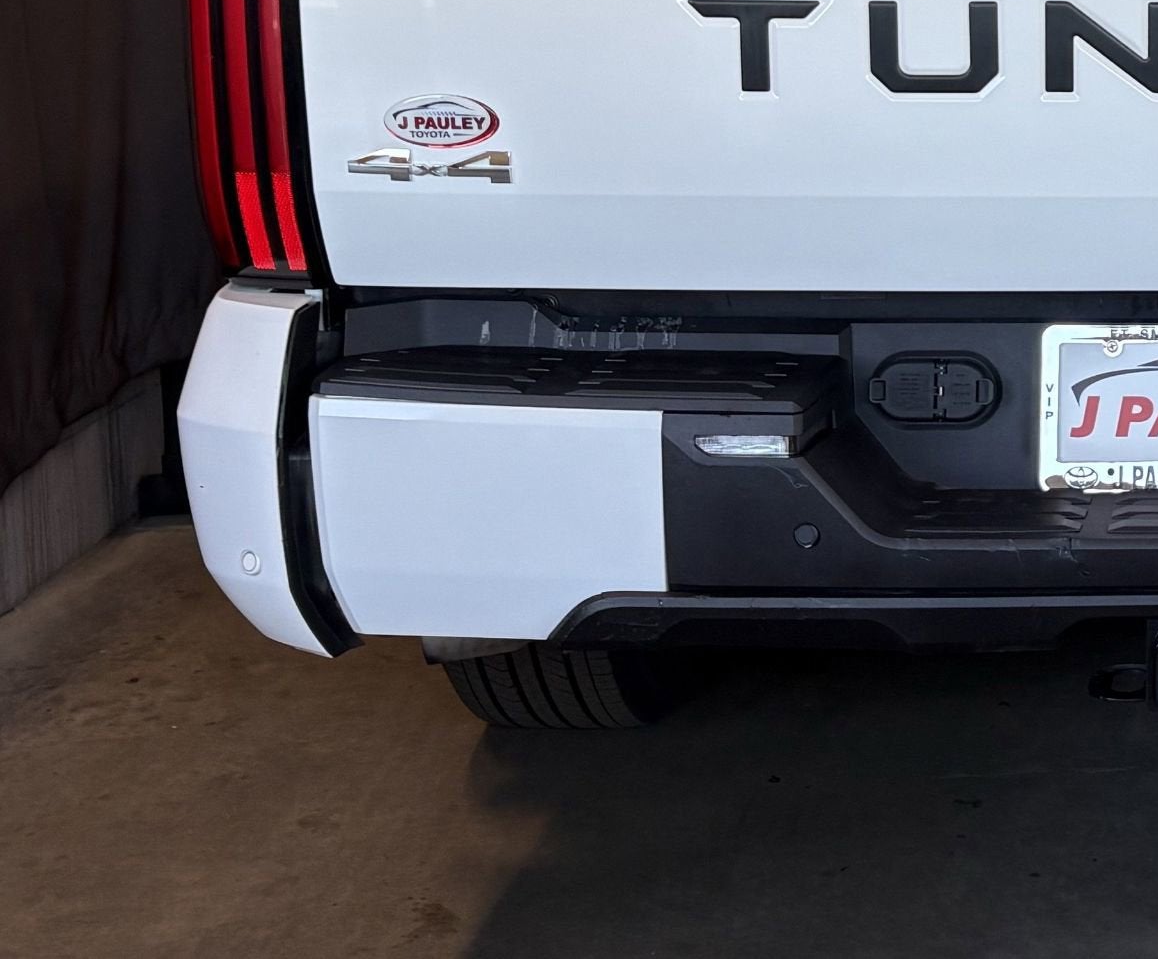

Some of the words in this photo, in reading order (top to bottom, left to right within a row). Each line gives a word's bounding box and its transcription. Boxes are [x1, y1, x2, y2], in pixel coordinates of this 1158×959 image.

[397, 116, 408, 130] J
[414, 117, 486, 130] PAULEY
[409, 131, 451, 139] TOYOTA
[1070, 396, 1100, 438] J
